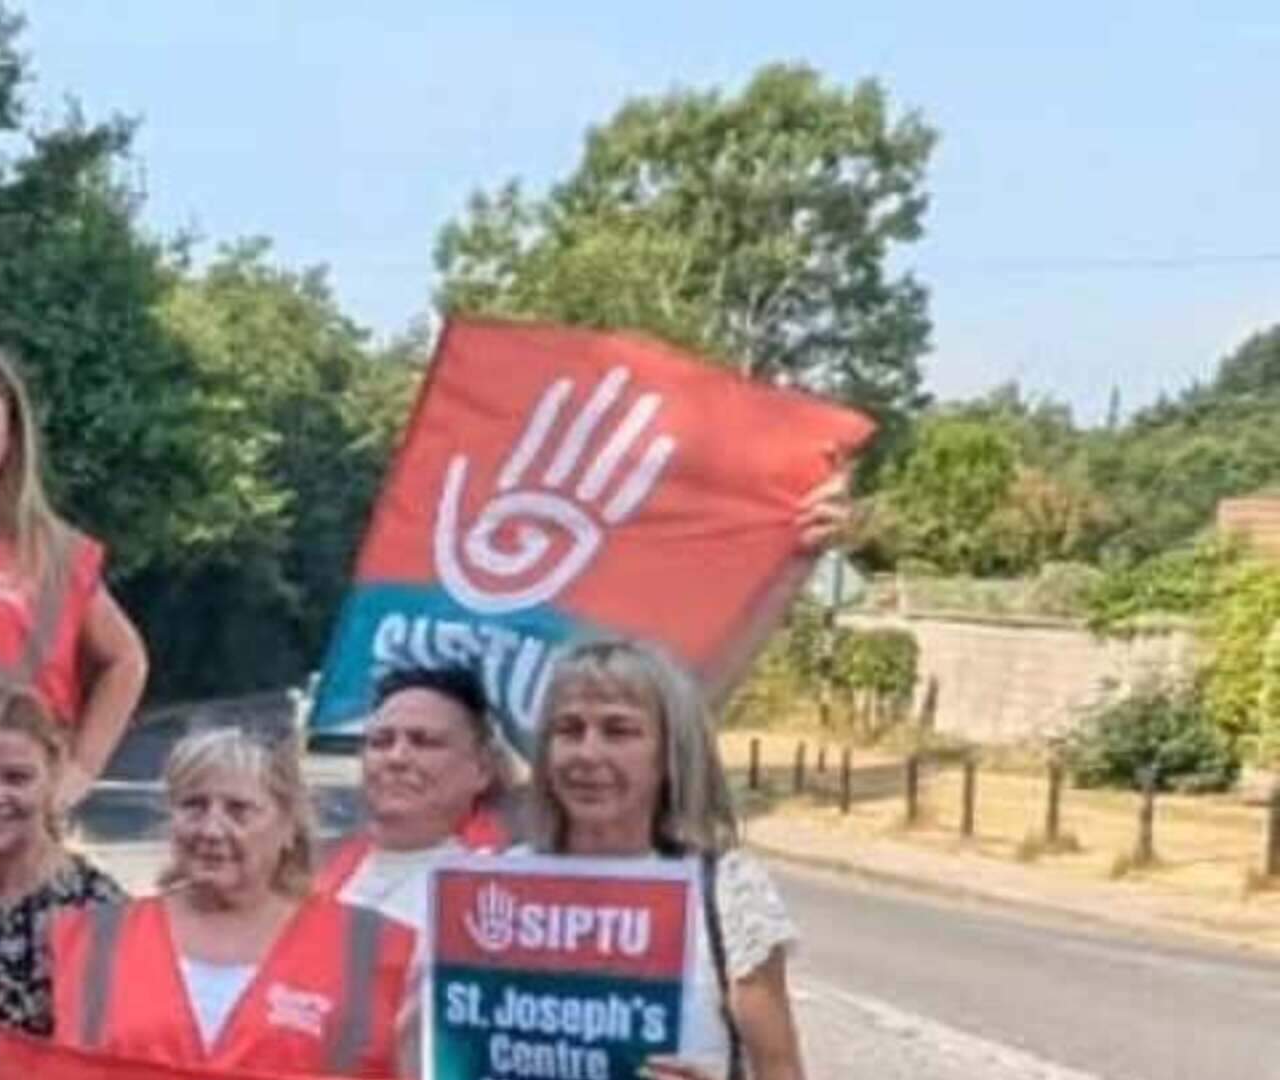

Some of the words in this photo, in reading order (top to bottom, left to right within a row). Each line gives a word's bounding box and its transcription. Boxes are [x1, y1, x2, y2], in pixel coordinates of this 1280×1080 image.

[520, 904, 651, 955] SIPTU
[446, 981, 488, 1027] St.
[495, 984, 667, 1043] Joseph's
